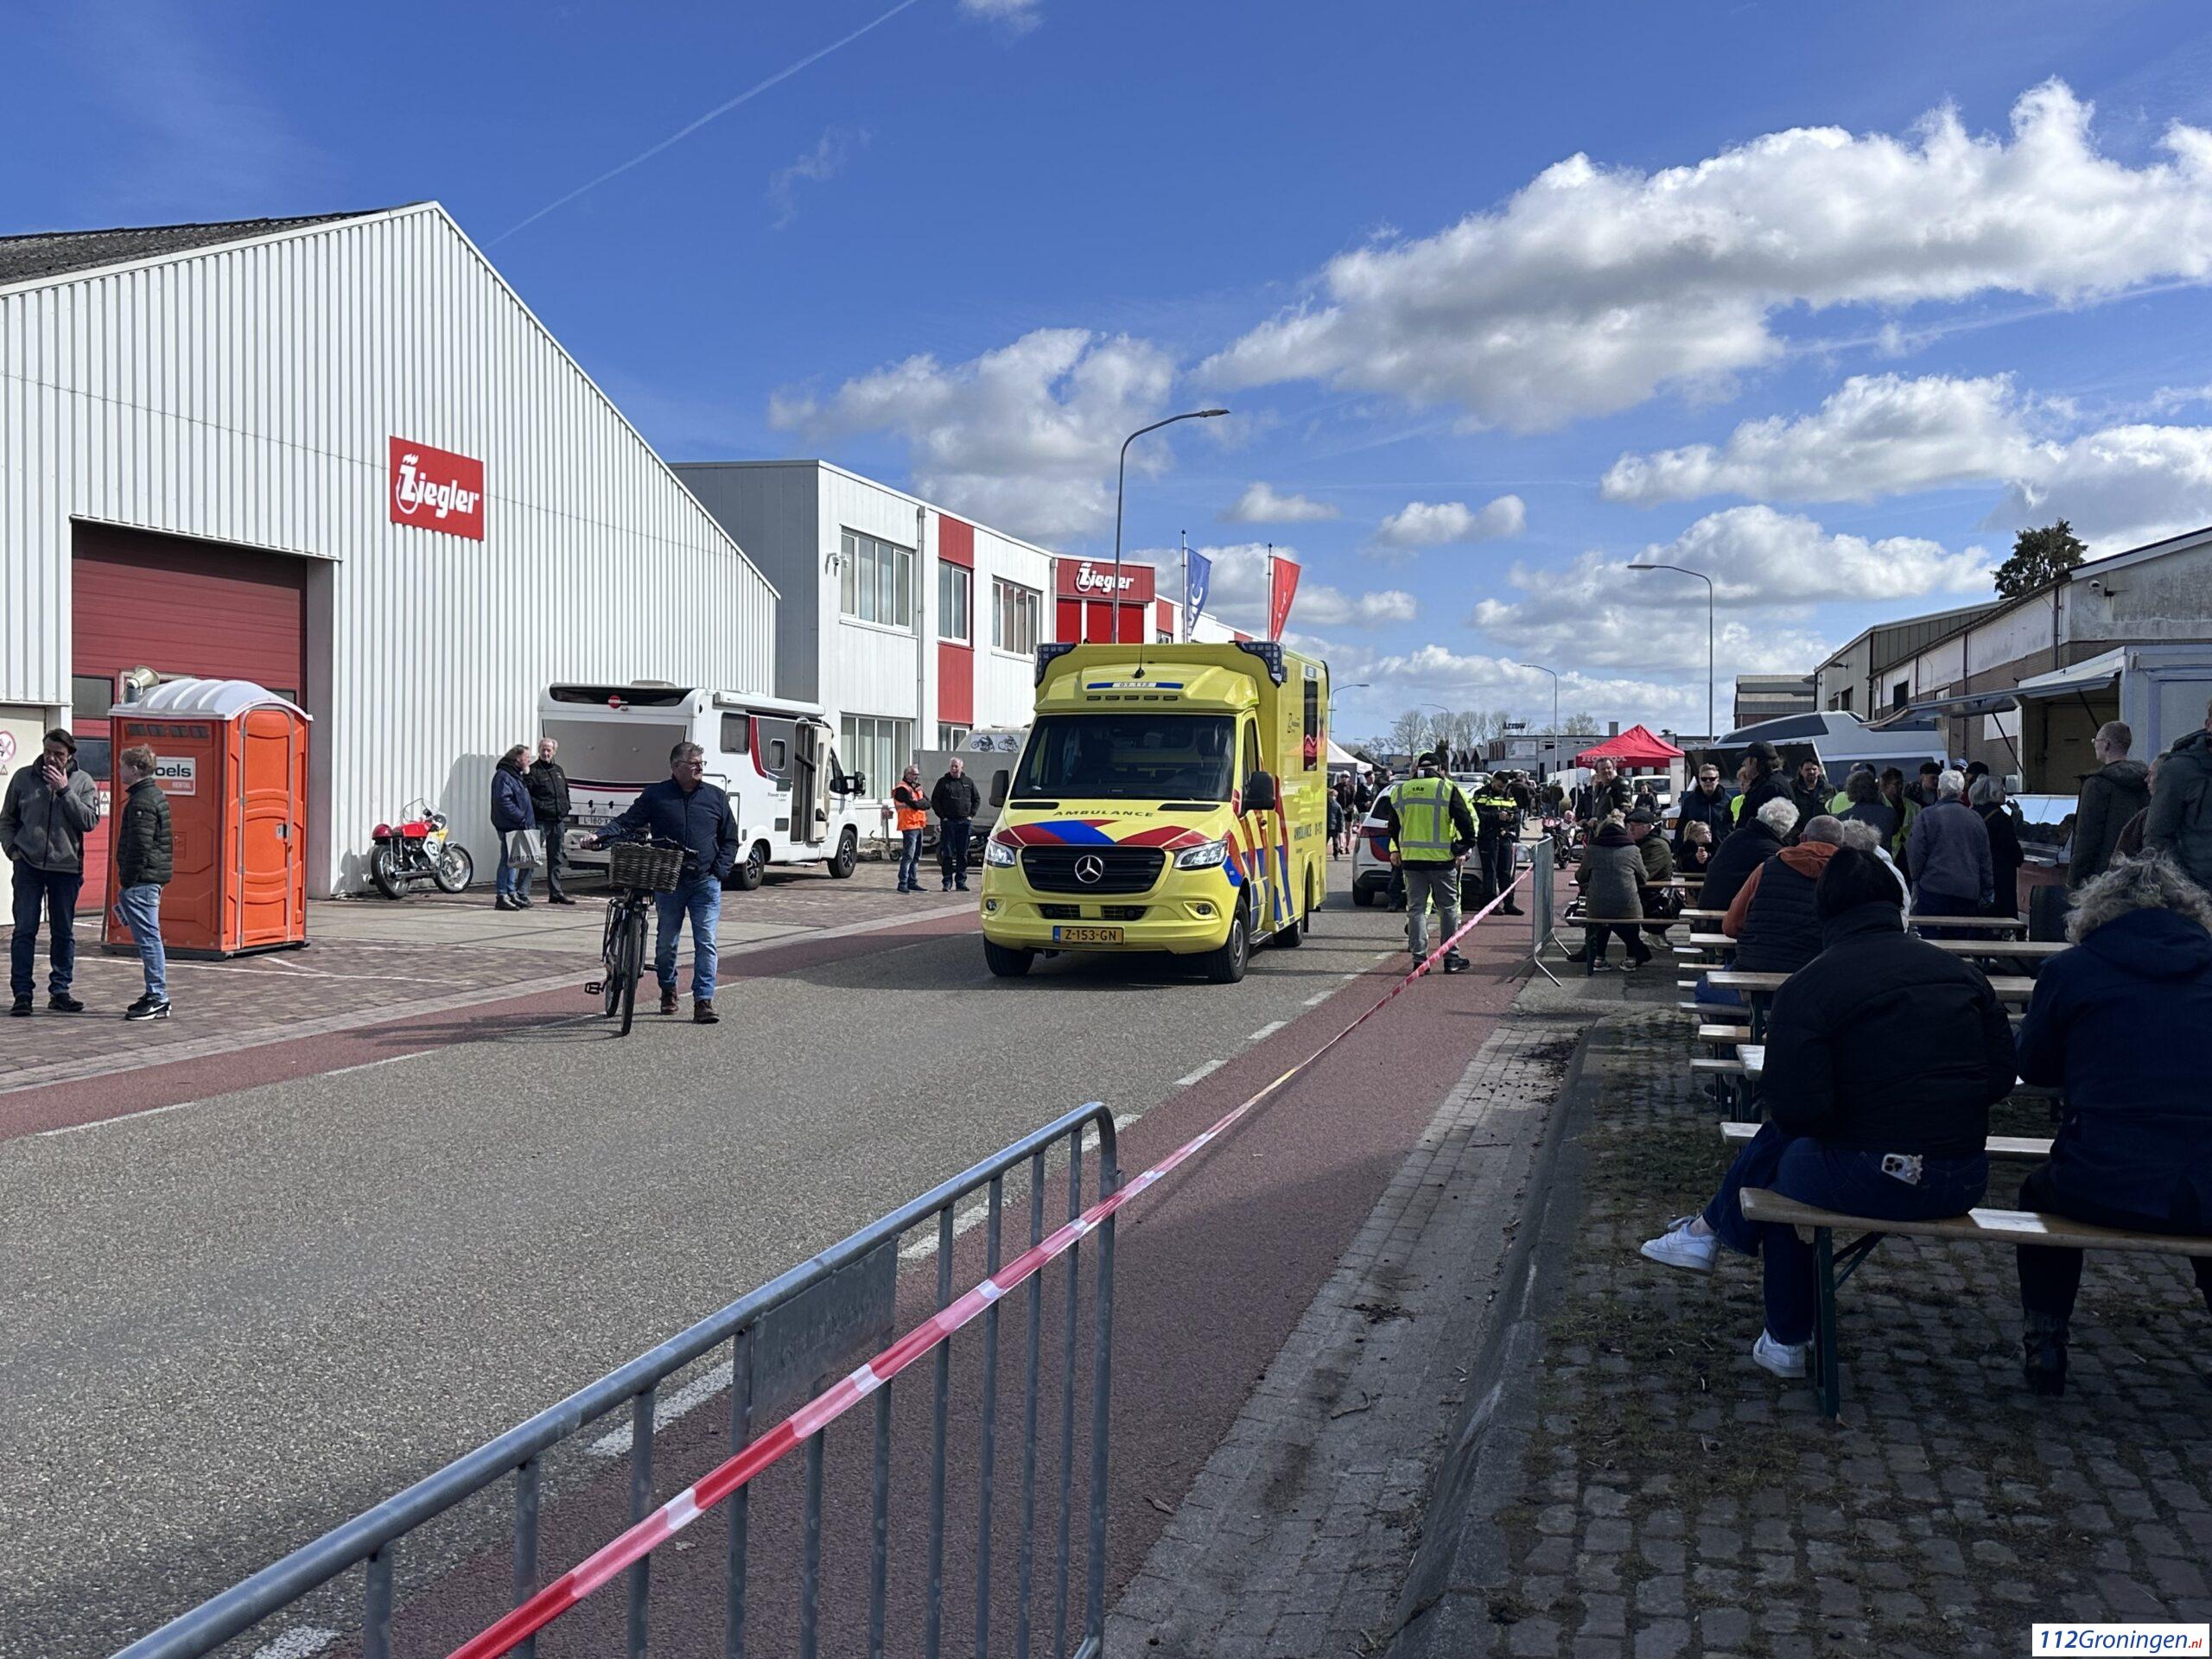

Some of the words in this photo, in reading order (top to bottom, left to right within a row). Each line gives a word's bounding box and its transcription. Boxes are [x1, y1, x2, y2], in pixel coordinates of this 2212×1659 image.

[396, 454, 480, 518] Ziegler
[1076, 563, 1135, 593] Ziegler
[154, 764, 192, 777] oels
[172, 781, 192, 790] RENTAL
[1065, 929, 1116, 941] Z-153-GN
